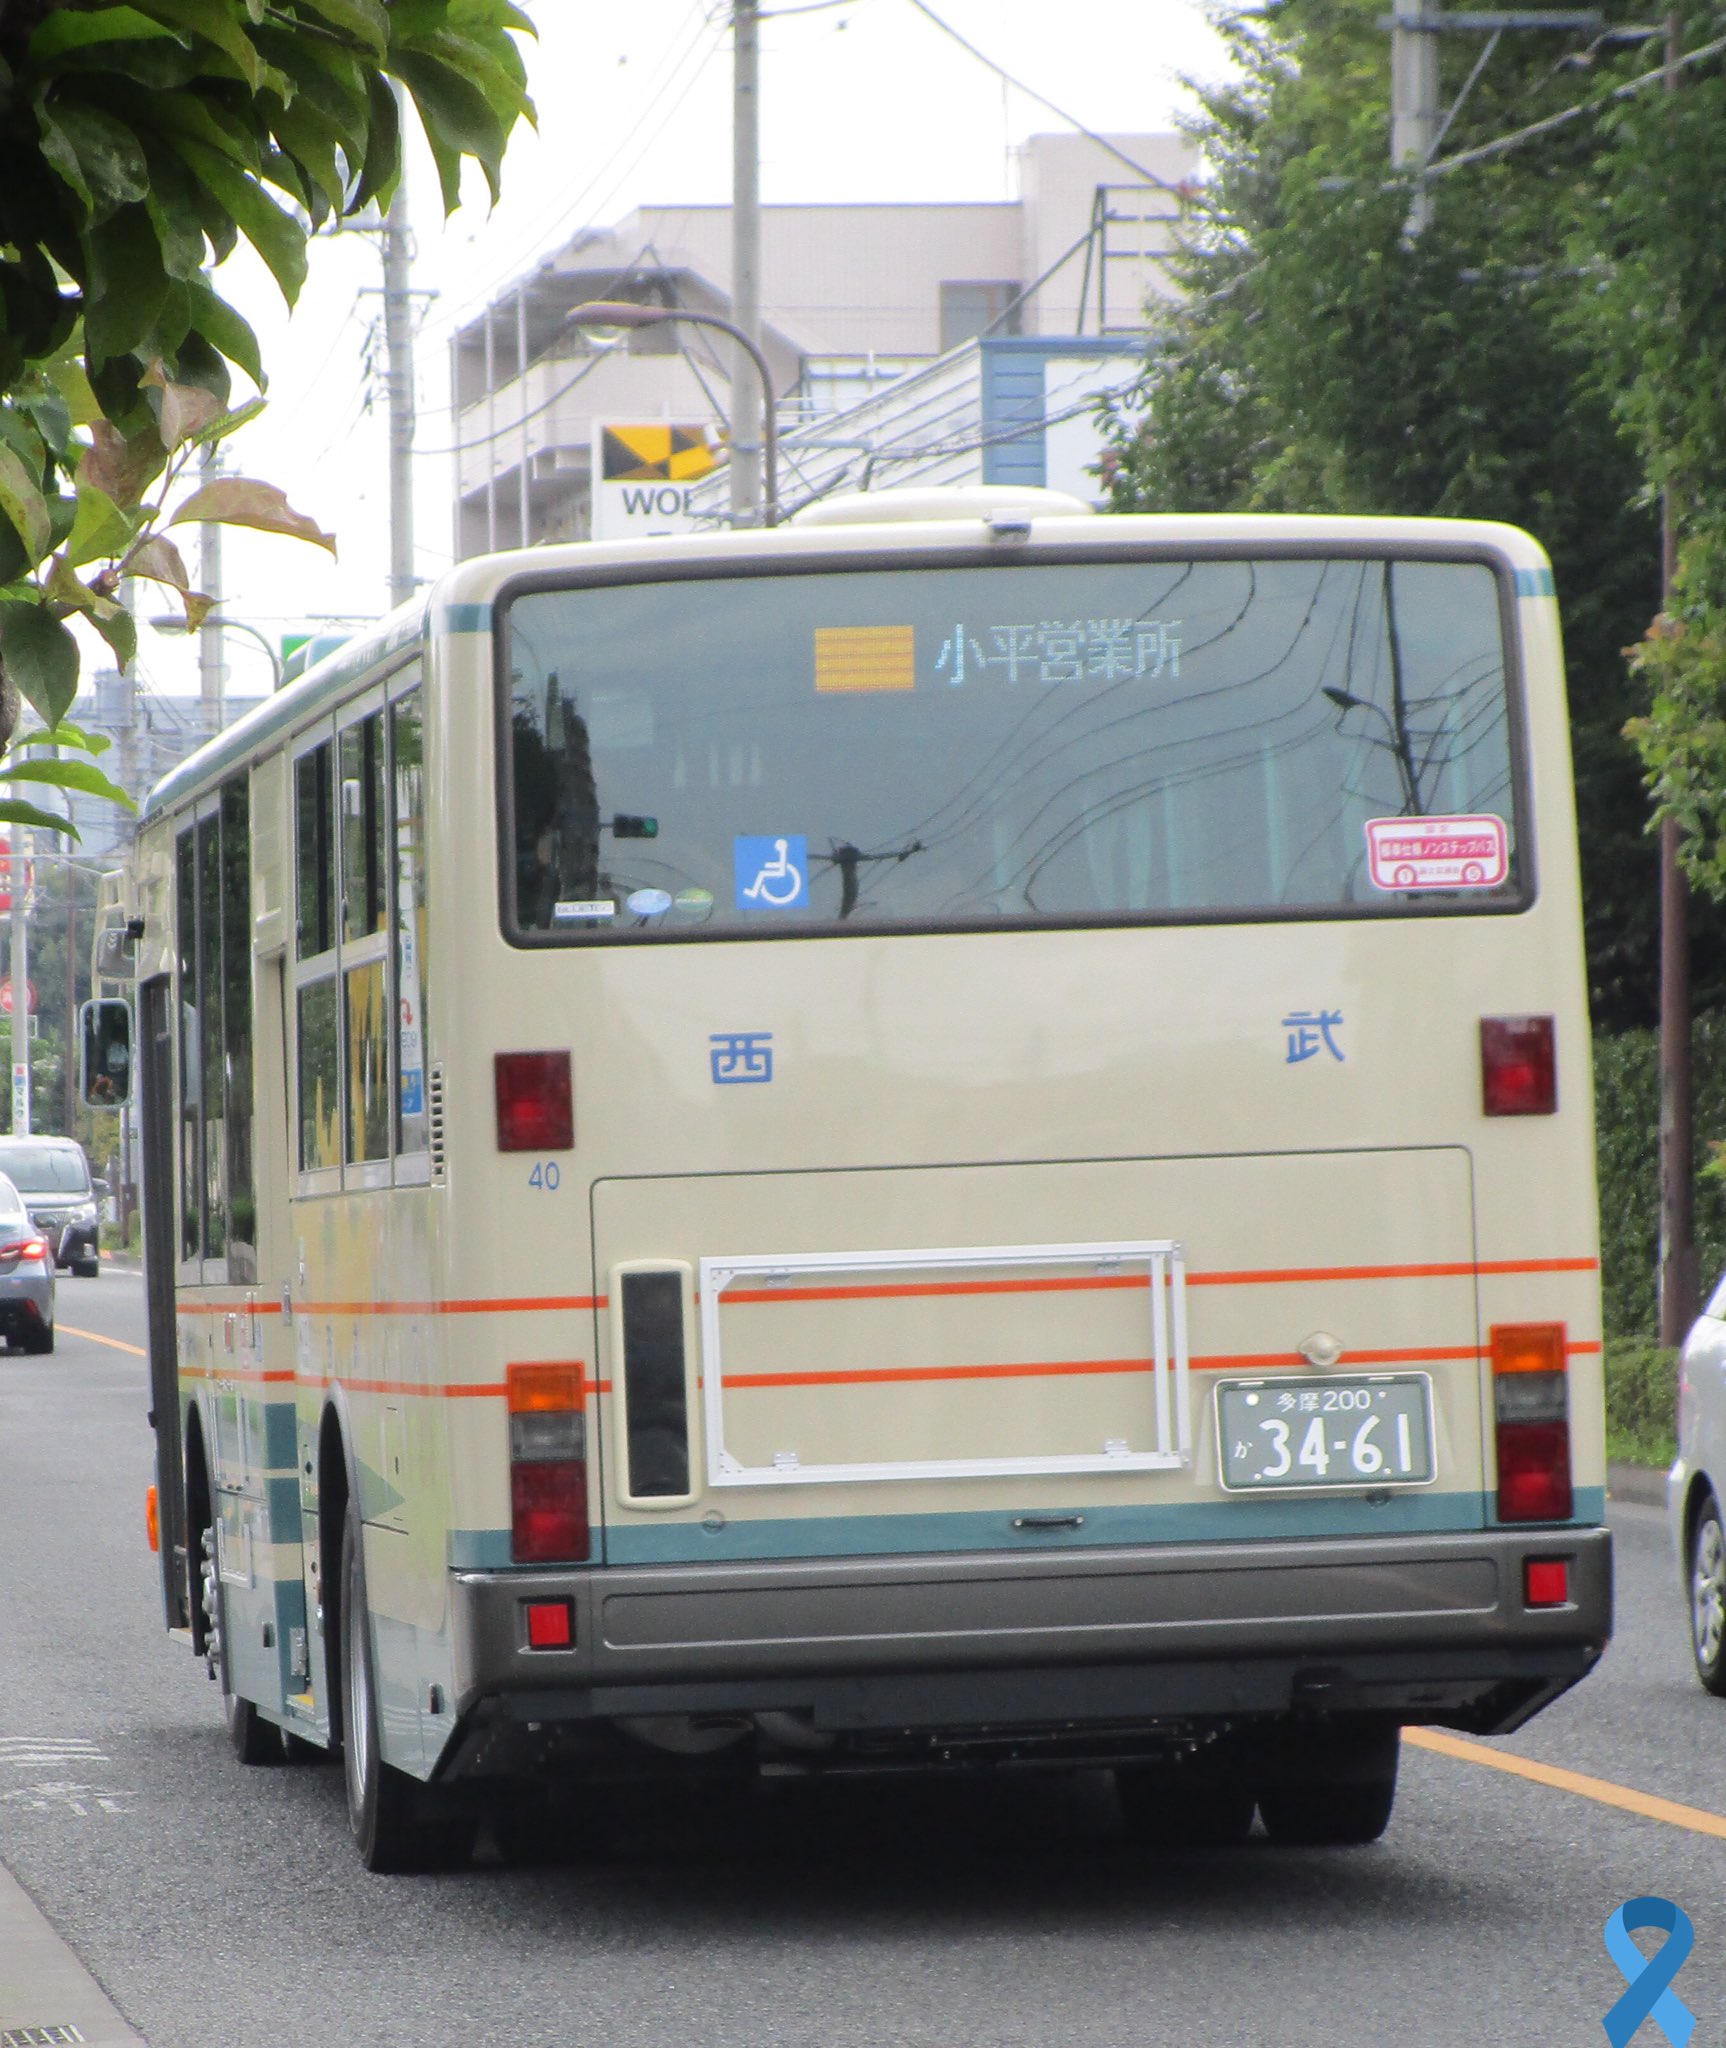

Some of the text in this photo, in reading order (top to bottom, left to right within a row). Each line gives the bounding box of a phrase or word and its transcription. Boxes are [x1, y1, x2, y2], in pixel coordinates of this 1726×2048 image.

[934, 618, 1184, 687] 小平営業所
[709, 1009, 1345, 1084] 西 武
[528, 1161, 560, 1190] 40
[1276, 1389, 1372, 1412] 多摩200
[1233, 1413, 1412, 1477] か 34-61
